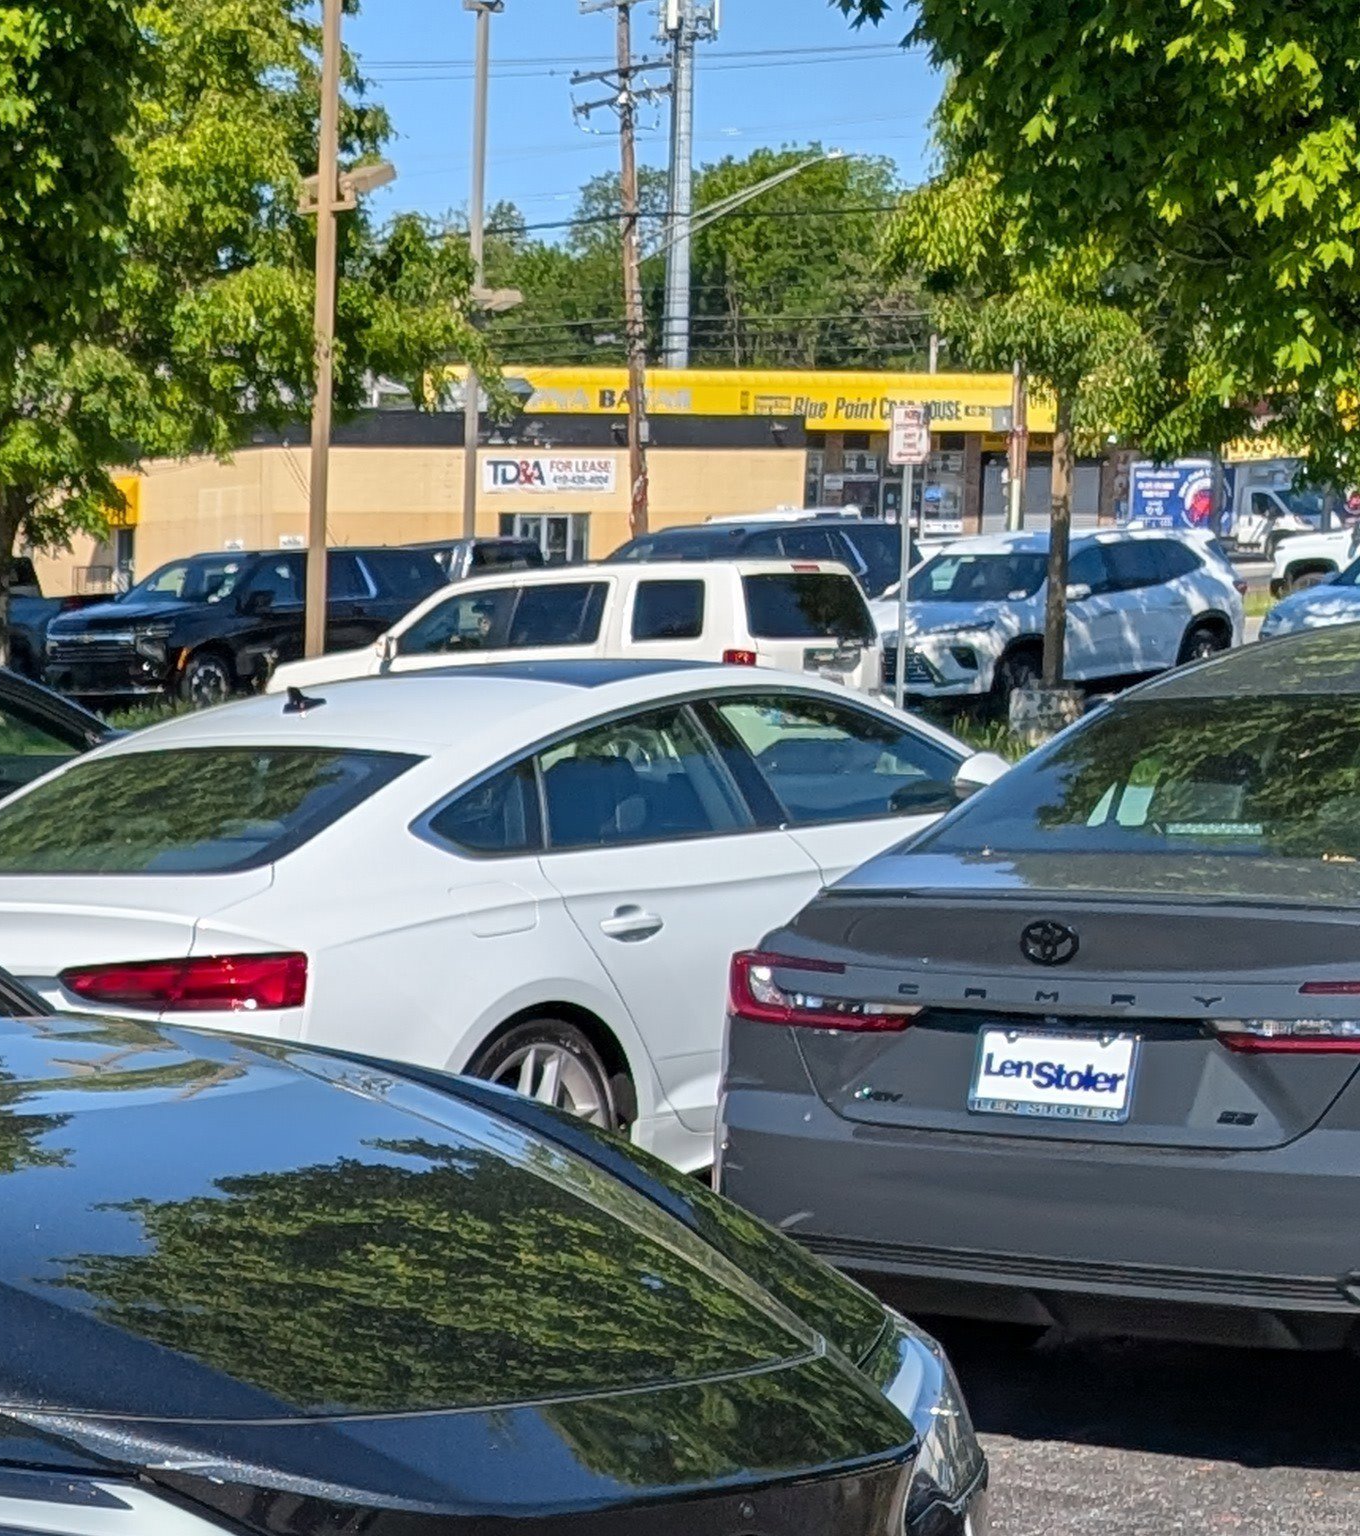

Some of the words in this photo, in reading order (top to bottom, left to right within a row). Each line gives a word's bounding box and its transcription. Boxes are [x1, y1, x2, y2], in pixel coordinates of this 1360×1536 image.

[833, 397, 877, 419] Point
[486, 460, 546, 485] TD&A
[549, 460, 573, 472] FOR
[575, 460, 611, 472] LEASE
[974, 1099, 1021, 1113] LEN
[1029, 1102, 1119, 1121] STOLER
